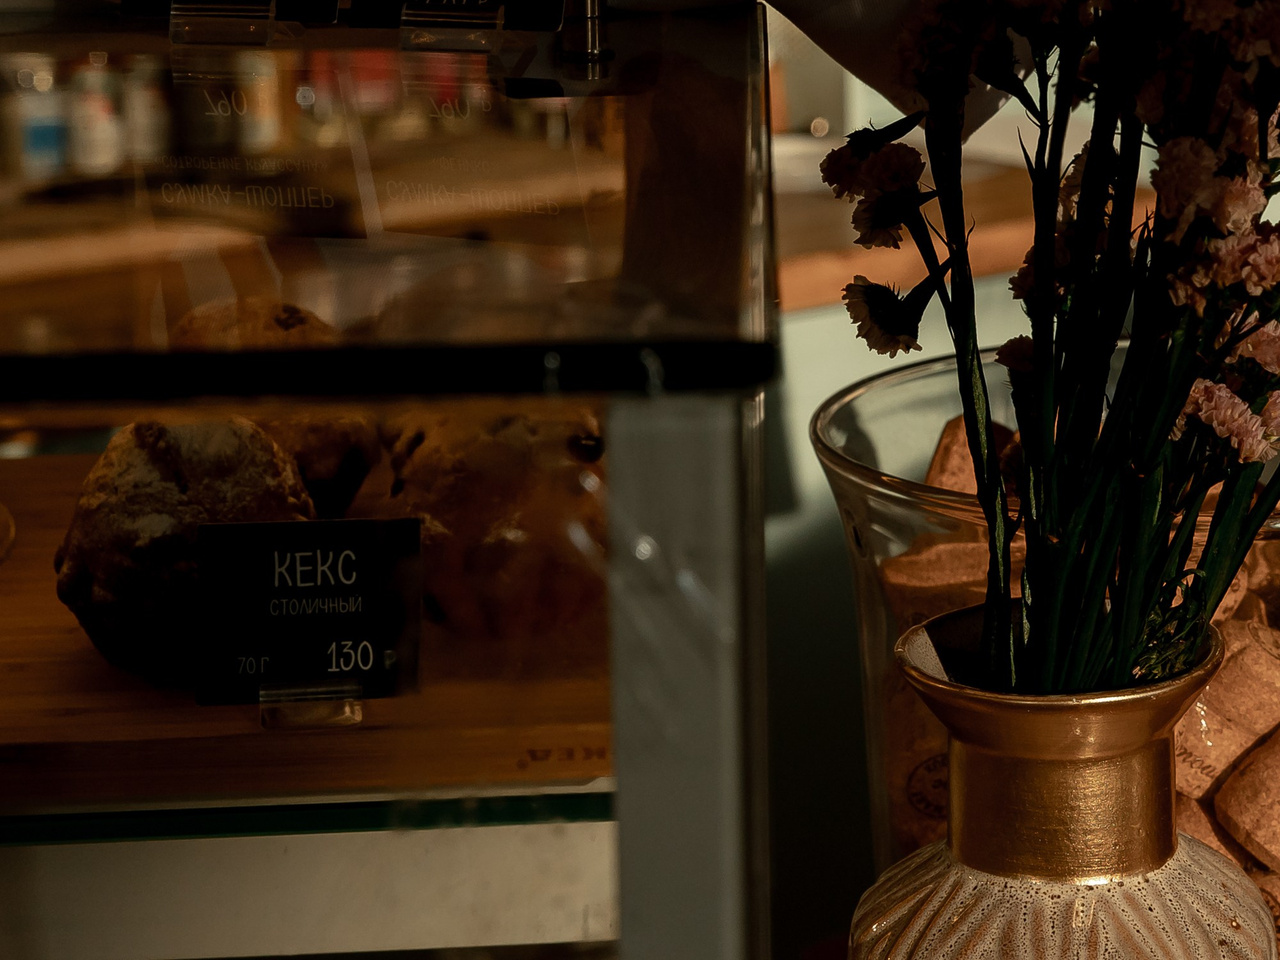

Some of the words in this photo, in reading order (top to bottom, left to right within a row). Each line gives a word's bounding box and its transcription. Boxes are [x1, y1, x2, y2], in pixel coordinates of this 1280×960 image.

[273, 549, 357, 588] КЕКС
[269, 594, 362, 617] СТОЛИЧНЫЙ
[326, 640, 374, 673] 130
